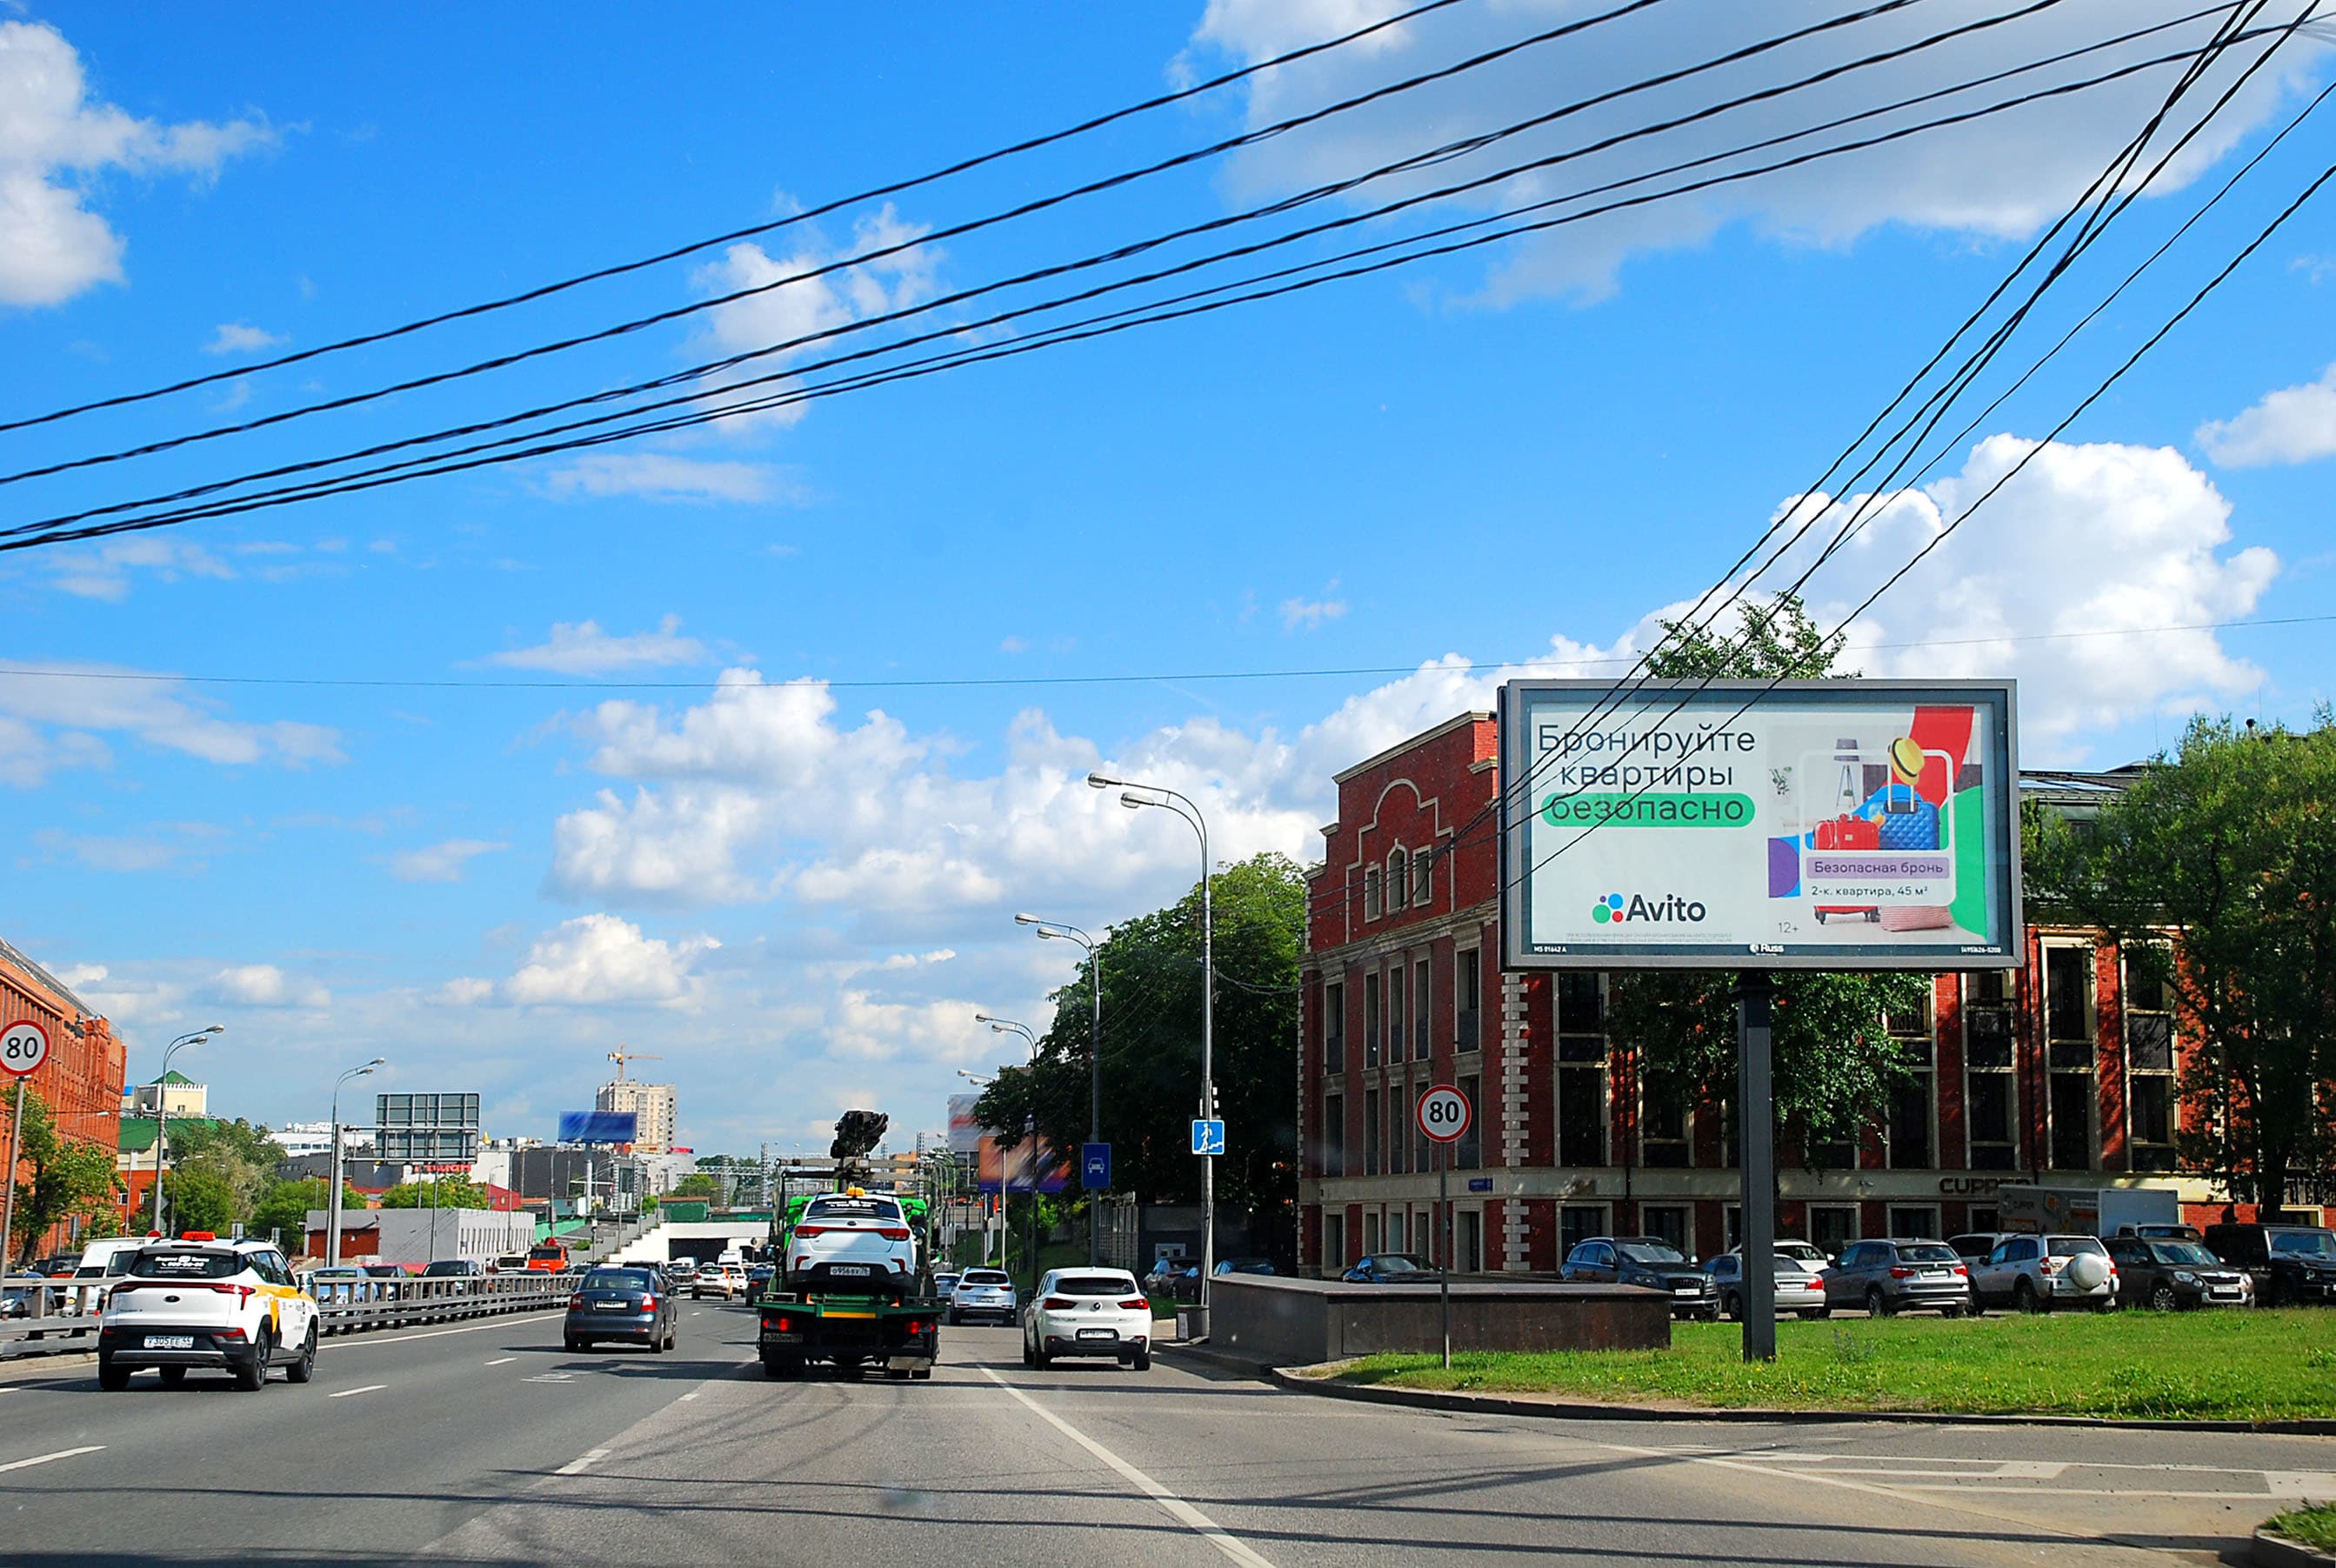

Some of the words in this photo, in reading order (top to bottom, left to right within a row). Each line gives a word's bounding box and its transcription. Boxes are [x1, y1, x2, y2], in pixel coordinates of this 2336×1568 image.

[1538, 724, 1755, 759] Бронируйте
[1561, 766, 1732, 793] квартиры
[1551, 796, 1744, 821] безопасно
[1814, 861, 1897, 873] Безопасная
[1901, 861, 1943, 874] бронь
[1812, 886, 1833, 896] 2-к.
[1836, 887, 1895, 897] квартира,
[1897, 886, 1912, 896] 45
[1915, 886, 1928, 896] м²
[1625, 894, 1706, 923] Avito
[1779, 922, 1799, 933] 12+
[1760, 944, 1785, 953] Russ
[6, 1036, 38, 1059] 80
[1429, 1100, 1459, 1124] 80
